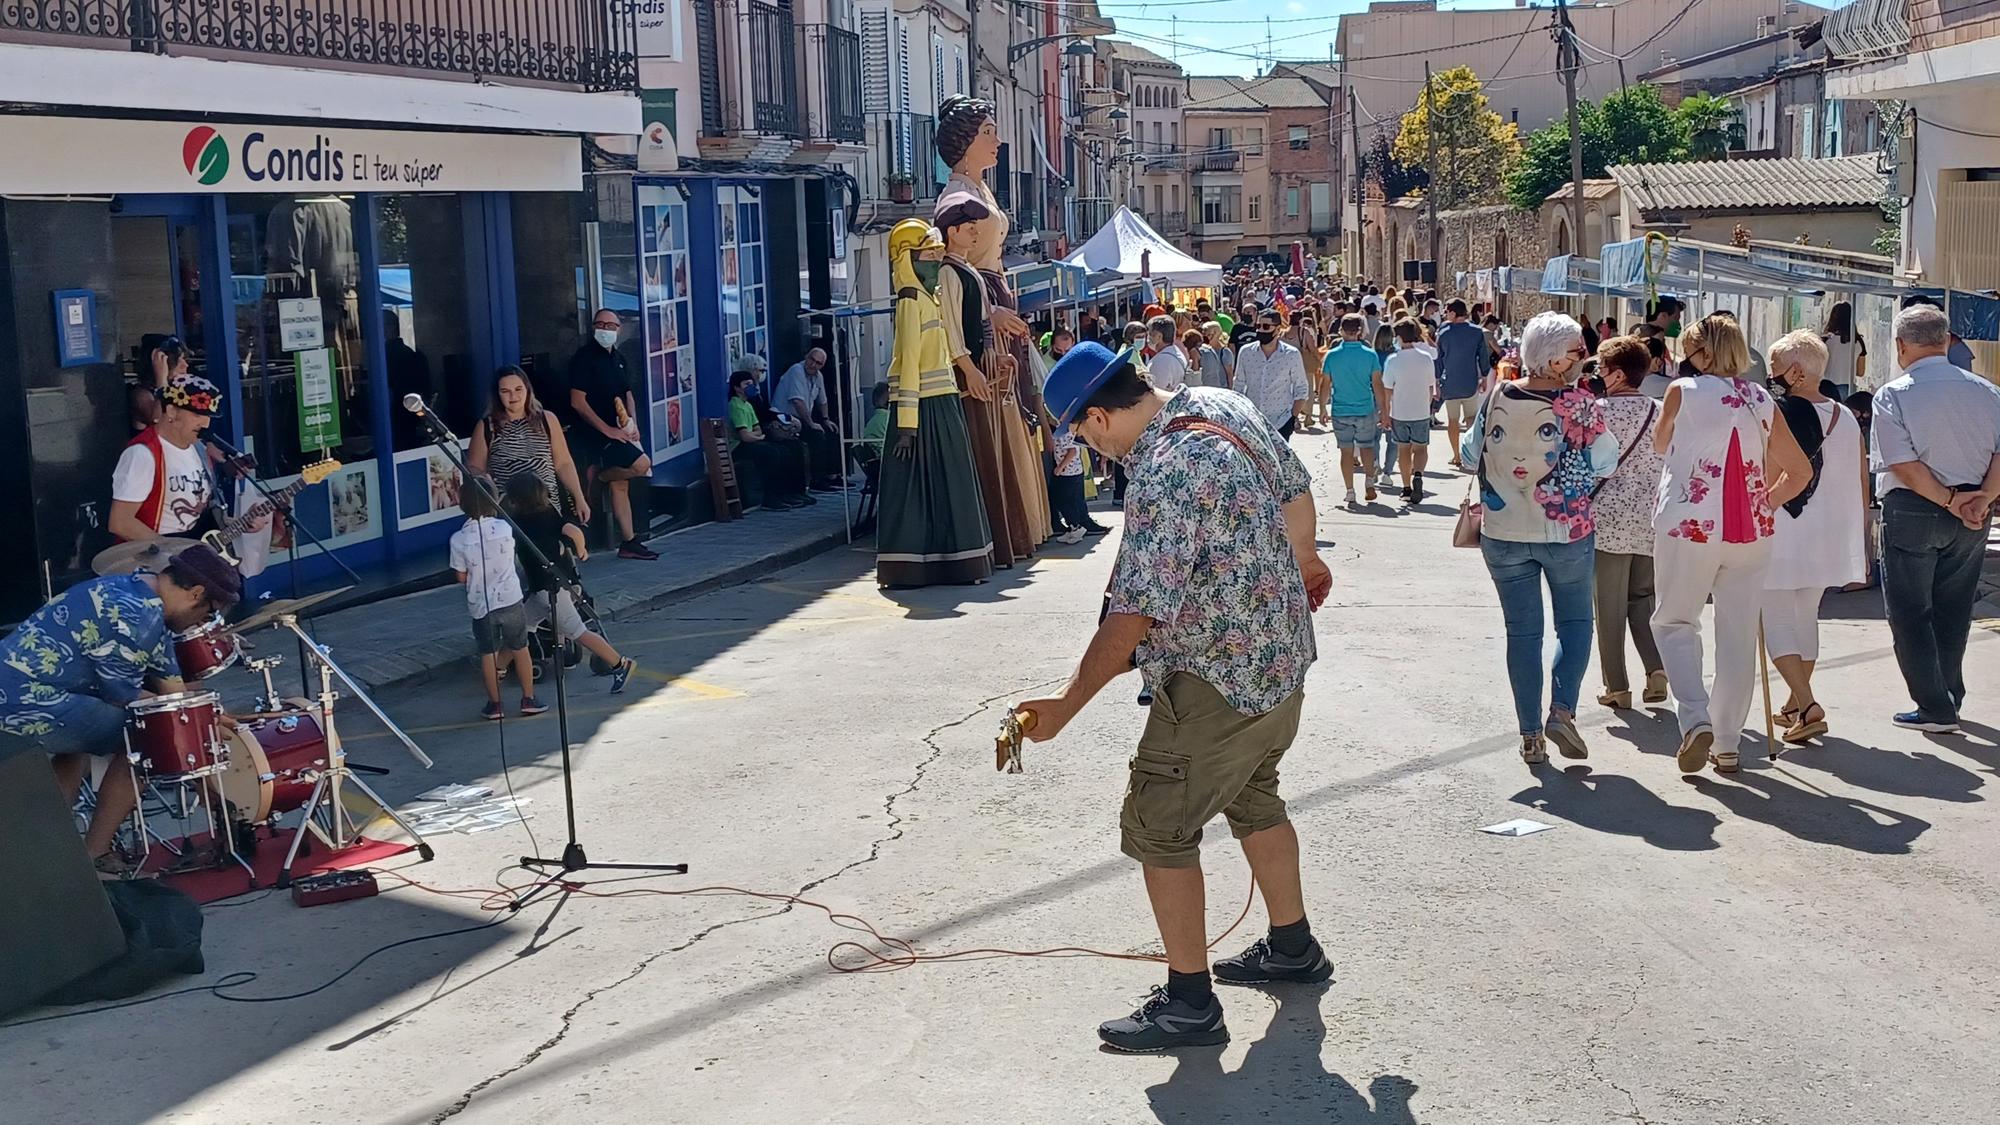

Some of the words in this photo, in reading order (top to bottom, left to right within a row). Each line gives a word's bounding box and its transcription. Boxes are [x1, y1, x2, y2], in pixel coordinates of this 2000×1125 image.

[242, 132, 344, 182] Condis
[353, 154, 369, 181] El
[373, 155, 399, 181] teu
[403, 157, 444, 188] súper
